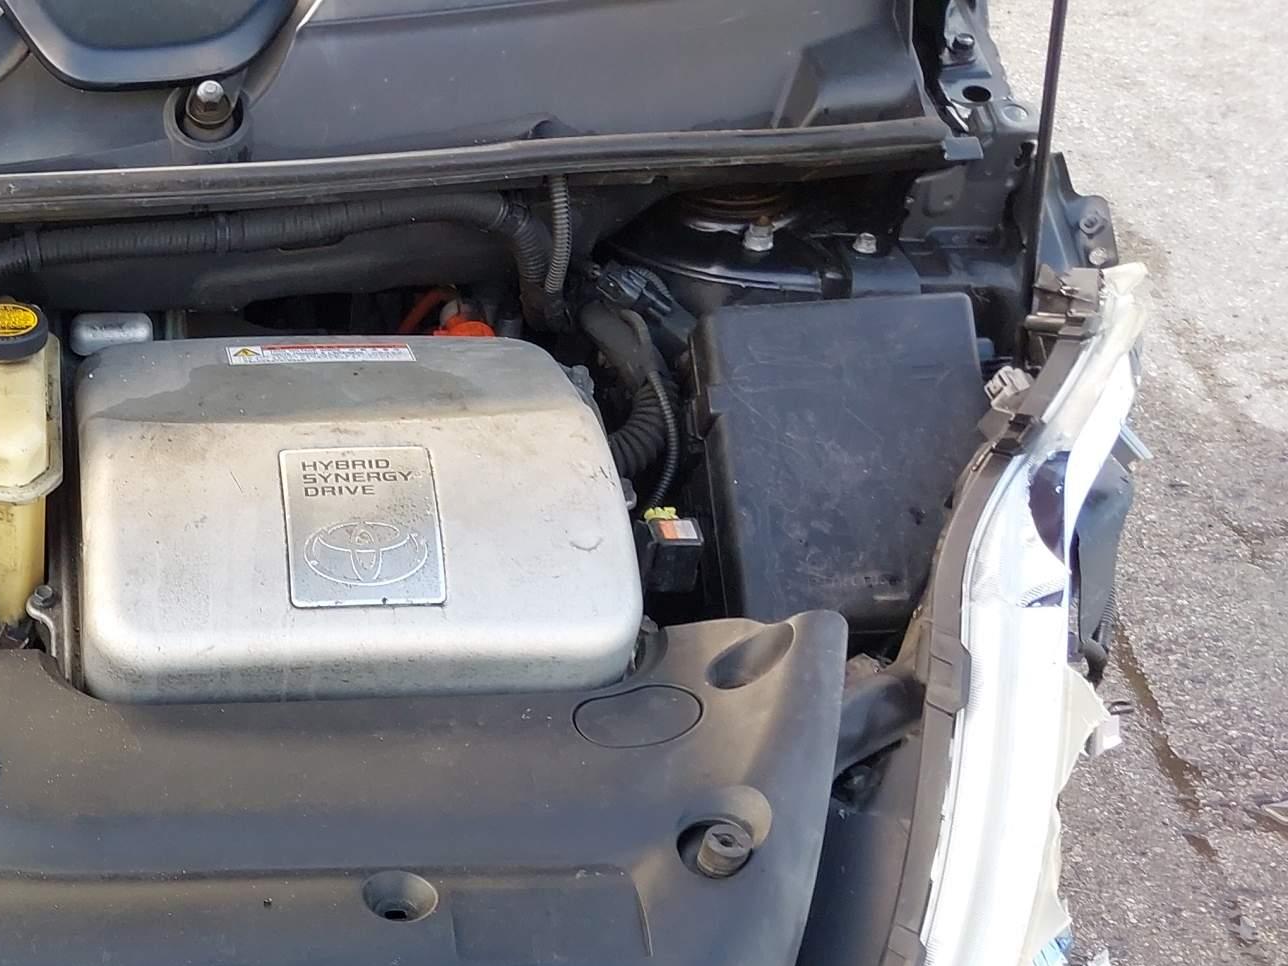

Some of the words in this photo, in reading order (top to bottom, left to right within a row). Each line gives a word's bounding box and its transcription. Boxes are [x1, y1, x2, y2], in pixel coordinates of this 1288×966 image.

[301, 458, 390, 472] HYBRID
[302, 471, 413, 485] SYNERGY
[304, 484, 376, 498] DRIVE
